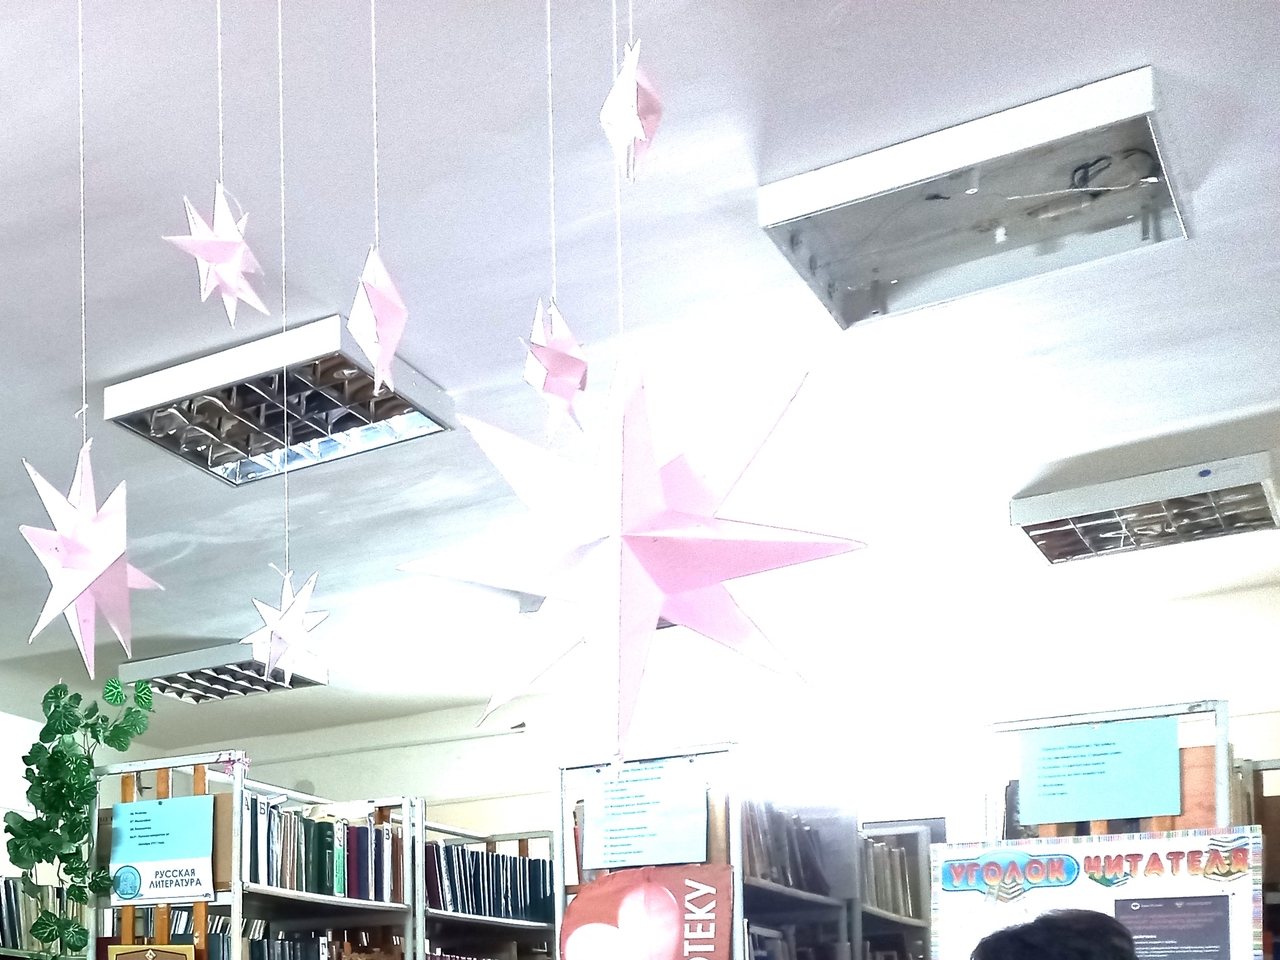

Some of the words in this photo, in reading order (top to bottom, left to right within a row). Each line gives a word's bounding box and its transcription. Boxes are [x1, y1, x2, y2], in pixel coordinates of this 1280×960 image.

[154, 868, 196, 879] РУССКАЯ
[949, 858, 1067, 888] УГОЛОК
[1083, 848, 1250, 878] ЧИТАТЕЛЯ
[148, 878, 202, 889] ЛИТЕРАТУРА
